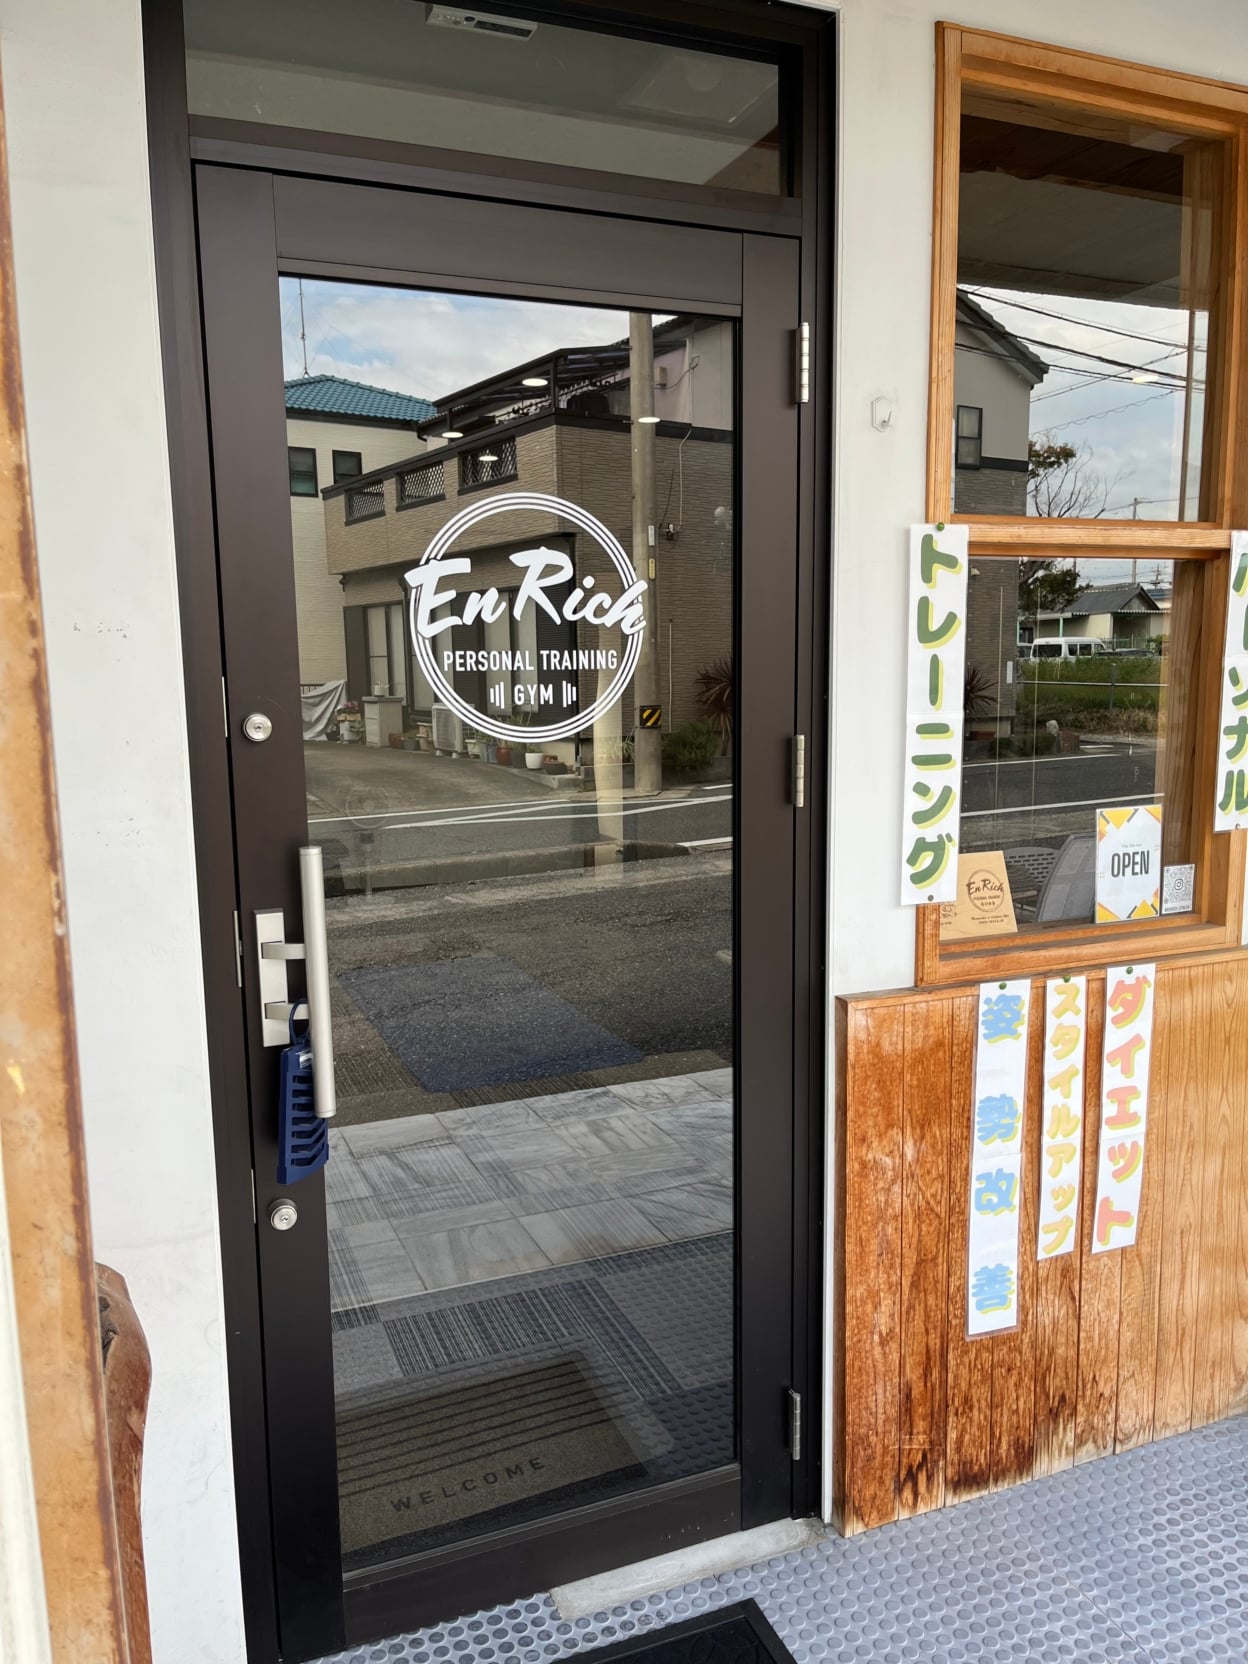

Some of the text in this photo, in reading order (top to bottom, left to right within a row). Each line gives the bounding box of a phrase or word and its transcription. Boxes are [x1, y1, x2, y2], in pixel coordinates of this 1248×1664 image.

[443, 649, 618, 672] PERSONAL TRAINING
[513, 683, 554, 705] GYM
[906, 533, 963, 889] トレーニング
[1111, 850, 1150, 878] OPEN
[971, 993, 1024, 1315] 姿勢改善
[1041, 982, 1081, 1255] スタイルアップ
[1096, 975, 1152, 1246] ダイエット
[389, 1457, 546, 1513] WELCOME
